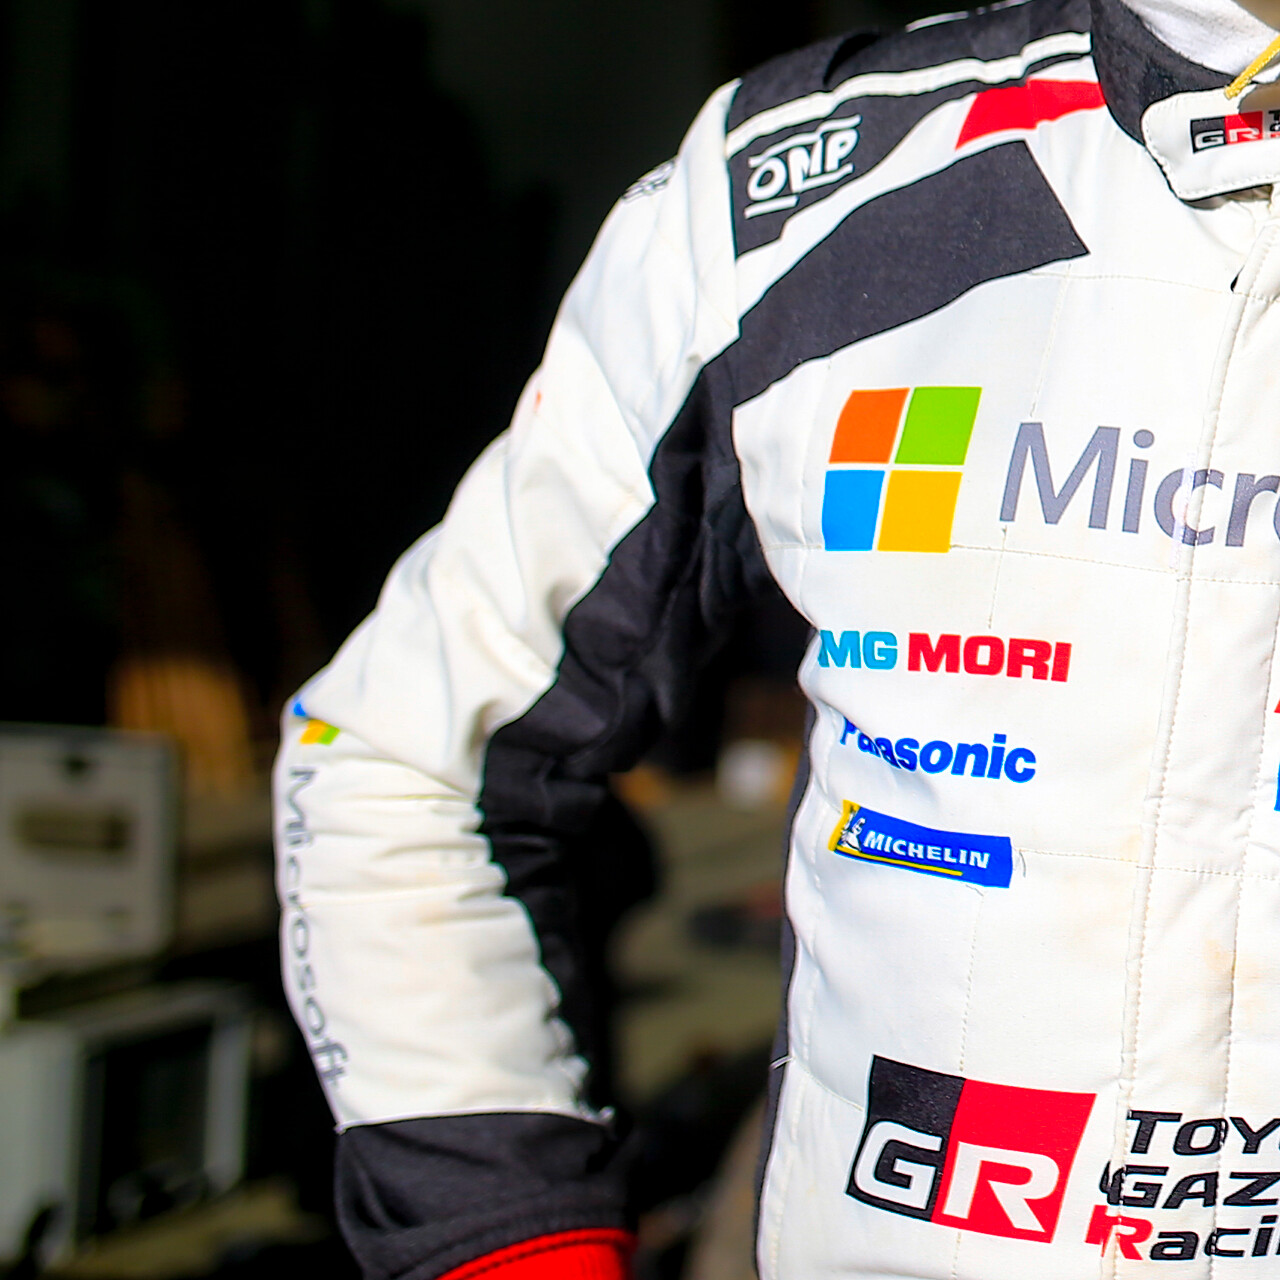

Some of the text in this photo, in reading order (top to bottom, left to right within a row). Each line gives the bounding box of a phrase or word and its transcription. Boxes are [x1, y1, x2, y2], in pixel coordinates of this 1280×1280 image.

[746, 127, 859, 201] OMP
[817, 629, 1072, 683] MG MORI
[839, 716, 1036, 783] Paasonic
[863, 830, 990, 869] MICHELIN
[854, 1121, 1060, 1233] GR
